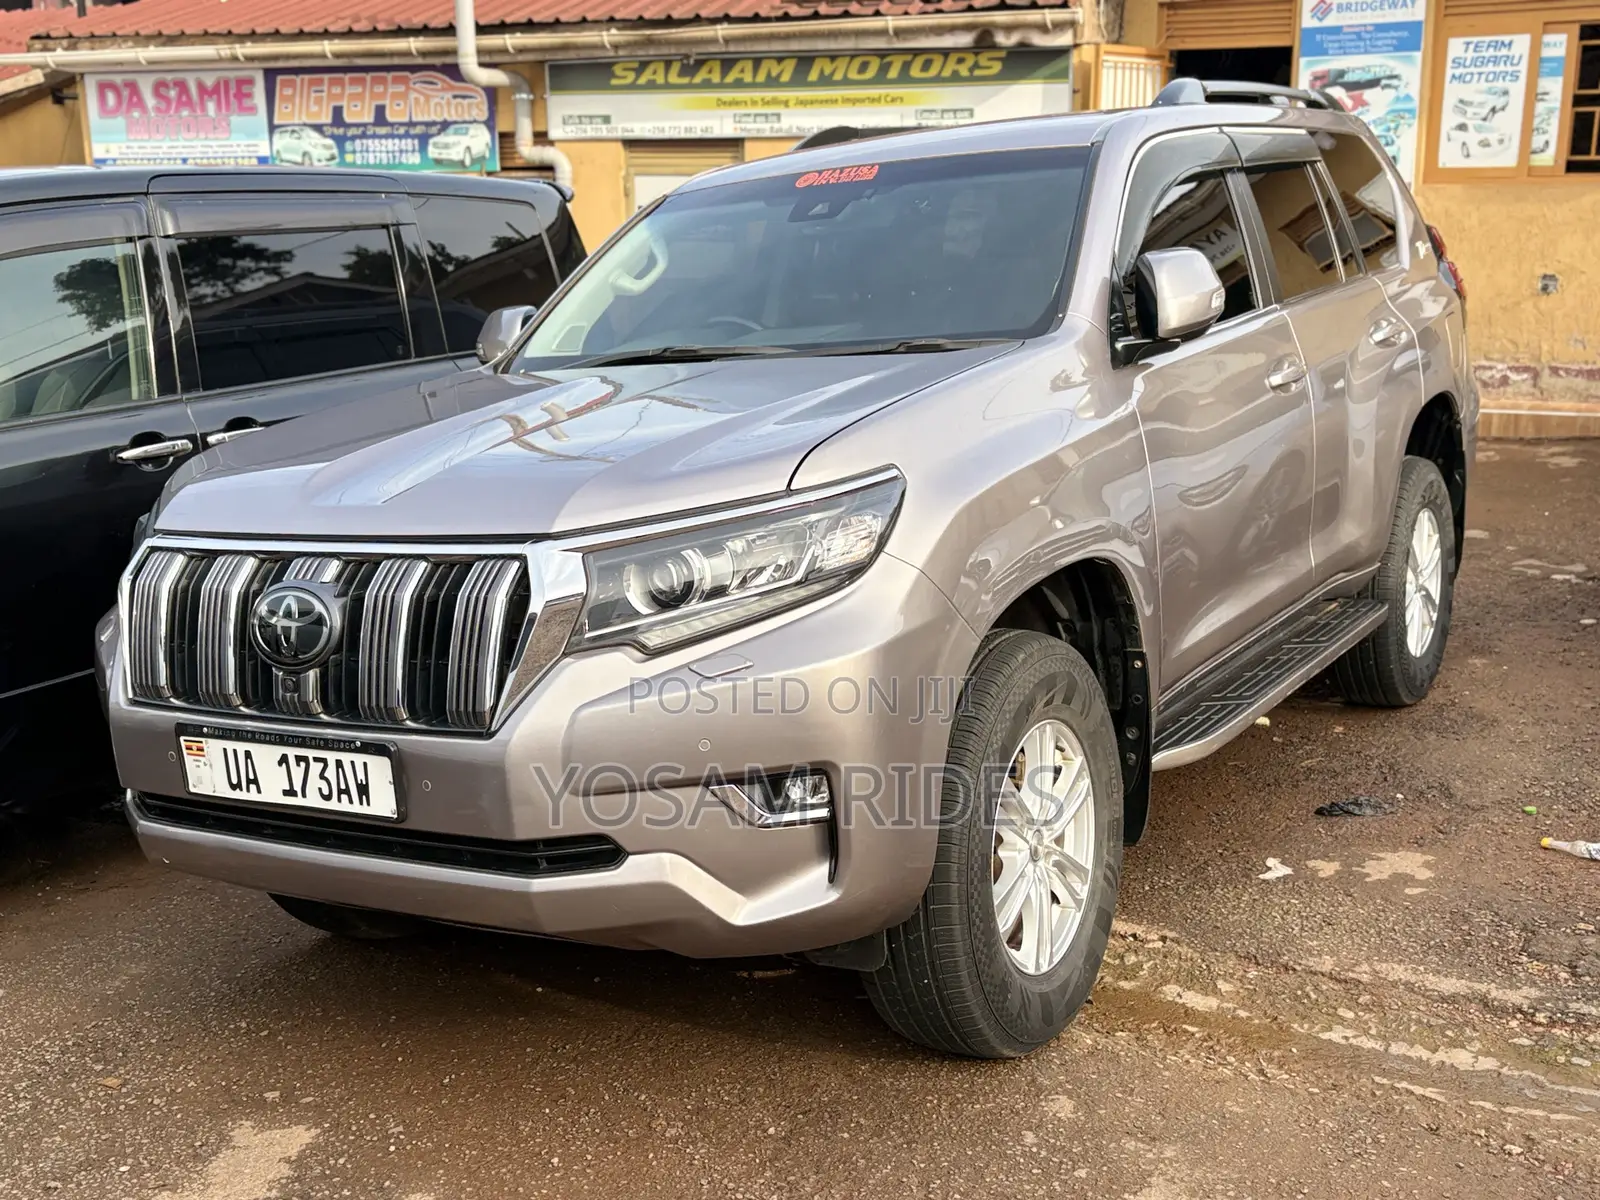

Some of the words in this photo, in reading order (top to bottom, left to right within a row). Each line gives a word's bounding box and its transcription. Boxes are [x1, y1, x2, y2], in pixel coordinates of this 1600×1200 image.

[1336, 0, 1417, 13] BRIDGEWAY
[1462, 39, 1514, 53] TEAM
[610, 58, 797, 85] SALAAM
[807, 51, 1007, 82] MOTORS
[1450, 54, 1523, 69] SUBARU
[1449, 70, 1522, 84] MOTORS
[96, 79, 149, 118] DA
[152, 75, 258, 117] SAMIE
[412, 93, 488, 122] Motors
[716, 97, 748, 107] Dealers
[761, 96, 790, 108] Selling
[841, 94, 882, 107] Imported
[884, 93, 904, 104] Cars
[126, 115, 232, 141] MOTORS
[207, 727, 235, 739] Making
[239, 730, 252, 739] the
[255, 731, 280, 743] Roads
[284, 734, 302, 744] Your
[306, 738, 325, 747] Safe
[328, 740, 355, 750] Space
[223, 747, 262, 794] UA
[277, 753, 371, 807] 173AW
